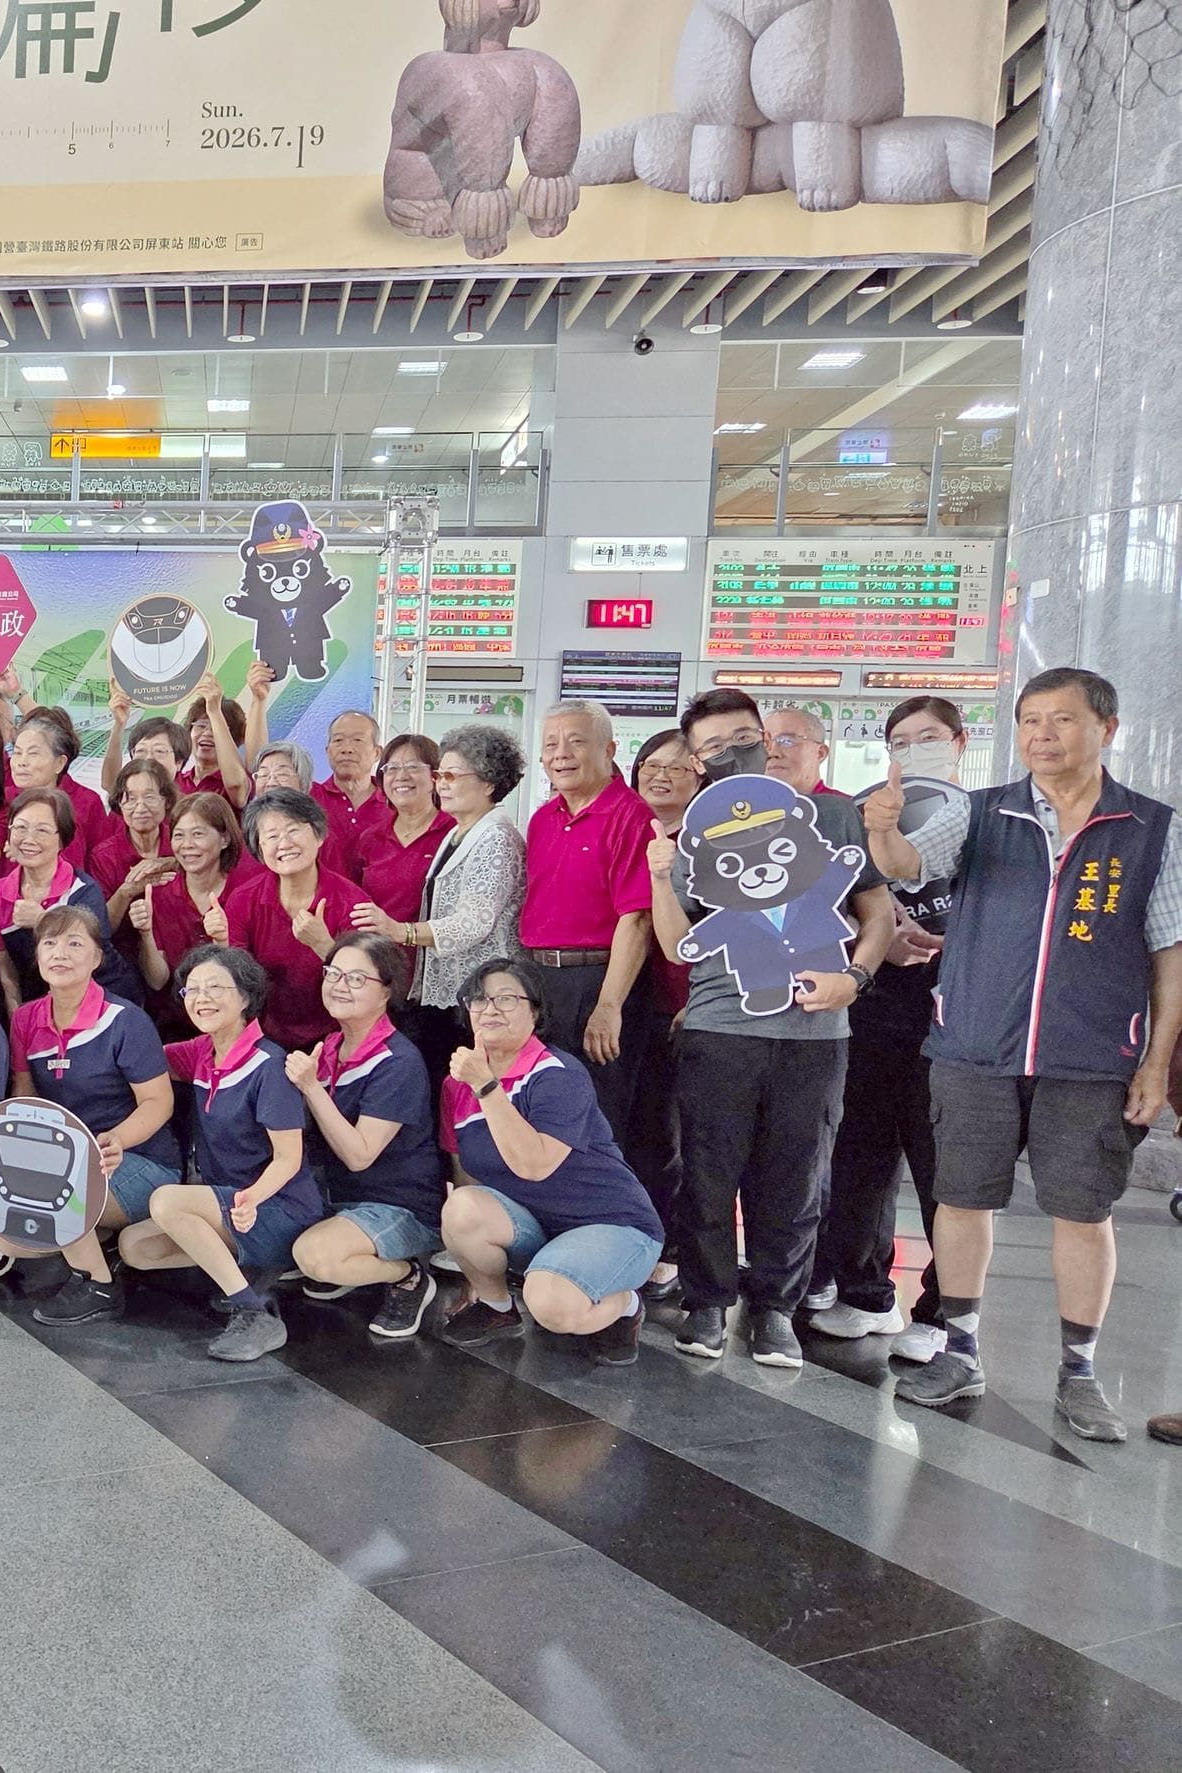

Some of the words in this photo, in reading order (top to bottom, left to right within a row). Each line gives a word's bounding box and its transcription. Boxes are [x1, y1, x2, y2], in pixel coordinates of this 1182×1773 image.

[201, 101, 243, 118] Sun.
[68, 144, 76, 155] 5
[108, 141, 114, 149] 6
[200, 124, 324, 168] 2026.7.19
[188, 235, 227, 249] 關心您
[621, 543, 669, 558] 售票處
[630, 559, 655, 567] Tickets
[963, 564, 988, 574] 北上
[600, 603, 647, 623] 11:47
[133, 685, 160, 694] FUTURE
[169, 683, 187, 691] NOW
[1067, 862, 1100, 942] 王基地
